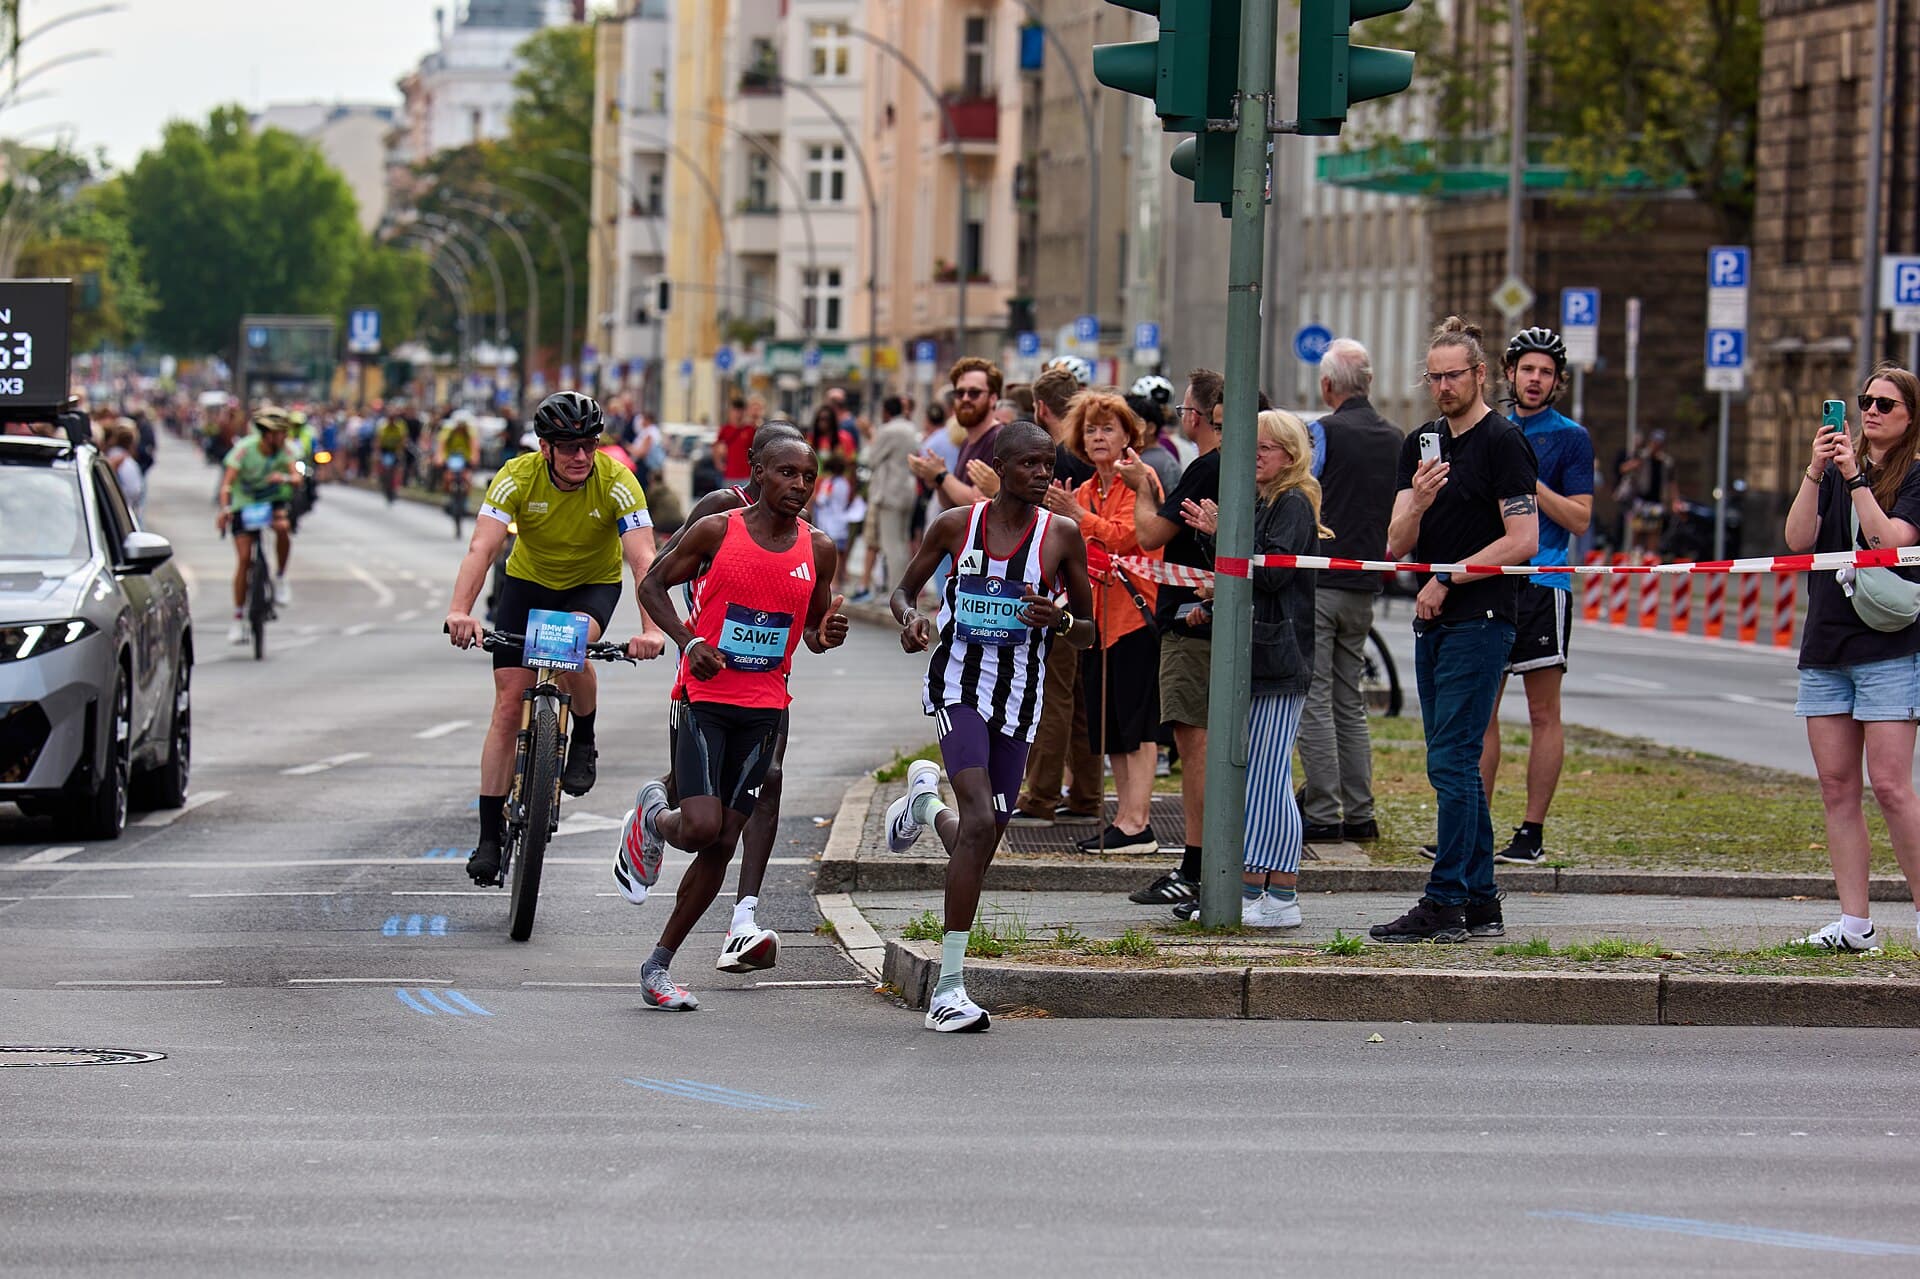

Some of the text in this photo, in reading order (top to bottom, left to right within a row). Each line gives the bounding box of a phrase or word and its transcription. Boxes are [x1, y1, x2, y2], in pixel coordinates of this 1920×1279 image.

[1715, 251, 1738, 285] P
[1566, 293, 1589, 324] P
[352, 311, 379, 341] U
[1712, 332, 1735, 365] P
[962, 598, 1025, 617] KIBITOK
[541, 623, 562, 632] BMW
[732, 626, 780, 646] SAWE
[970, 627, 1009, 638] zalando
[528, 658, 578, 670] FREIE FAHRT
[734, 655, 769, 665] zalando
